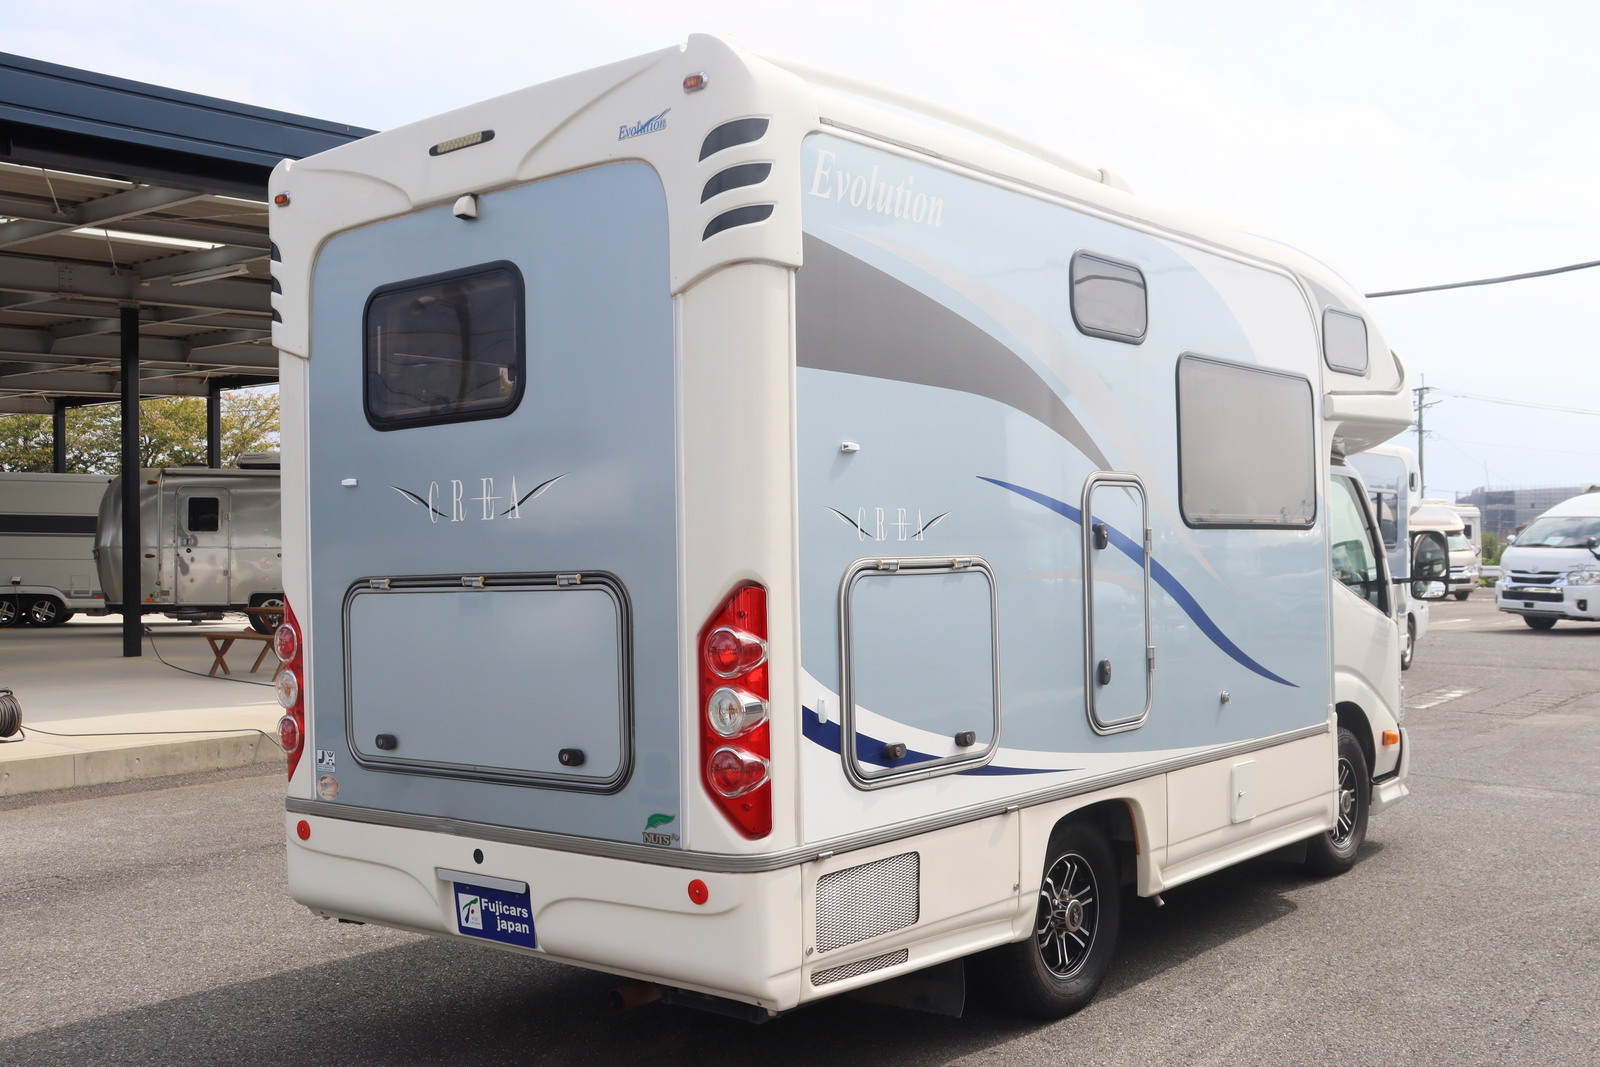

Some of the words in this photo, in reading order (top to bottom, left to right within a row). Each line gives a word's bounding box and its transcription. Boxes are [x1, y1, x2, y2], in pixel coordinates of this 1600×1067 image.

[808, 148, 944, 228] Evolution
[428, 475, 521, 523] CREA
[857, 506, 924, 541] CREA
[642, 832, 671, 846] NUTS
[481, 898, 529, 918] Fujicars
[497, 916, 530, 934] japan
